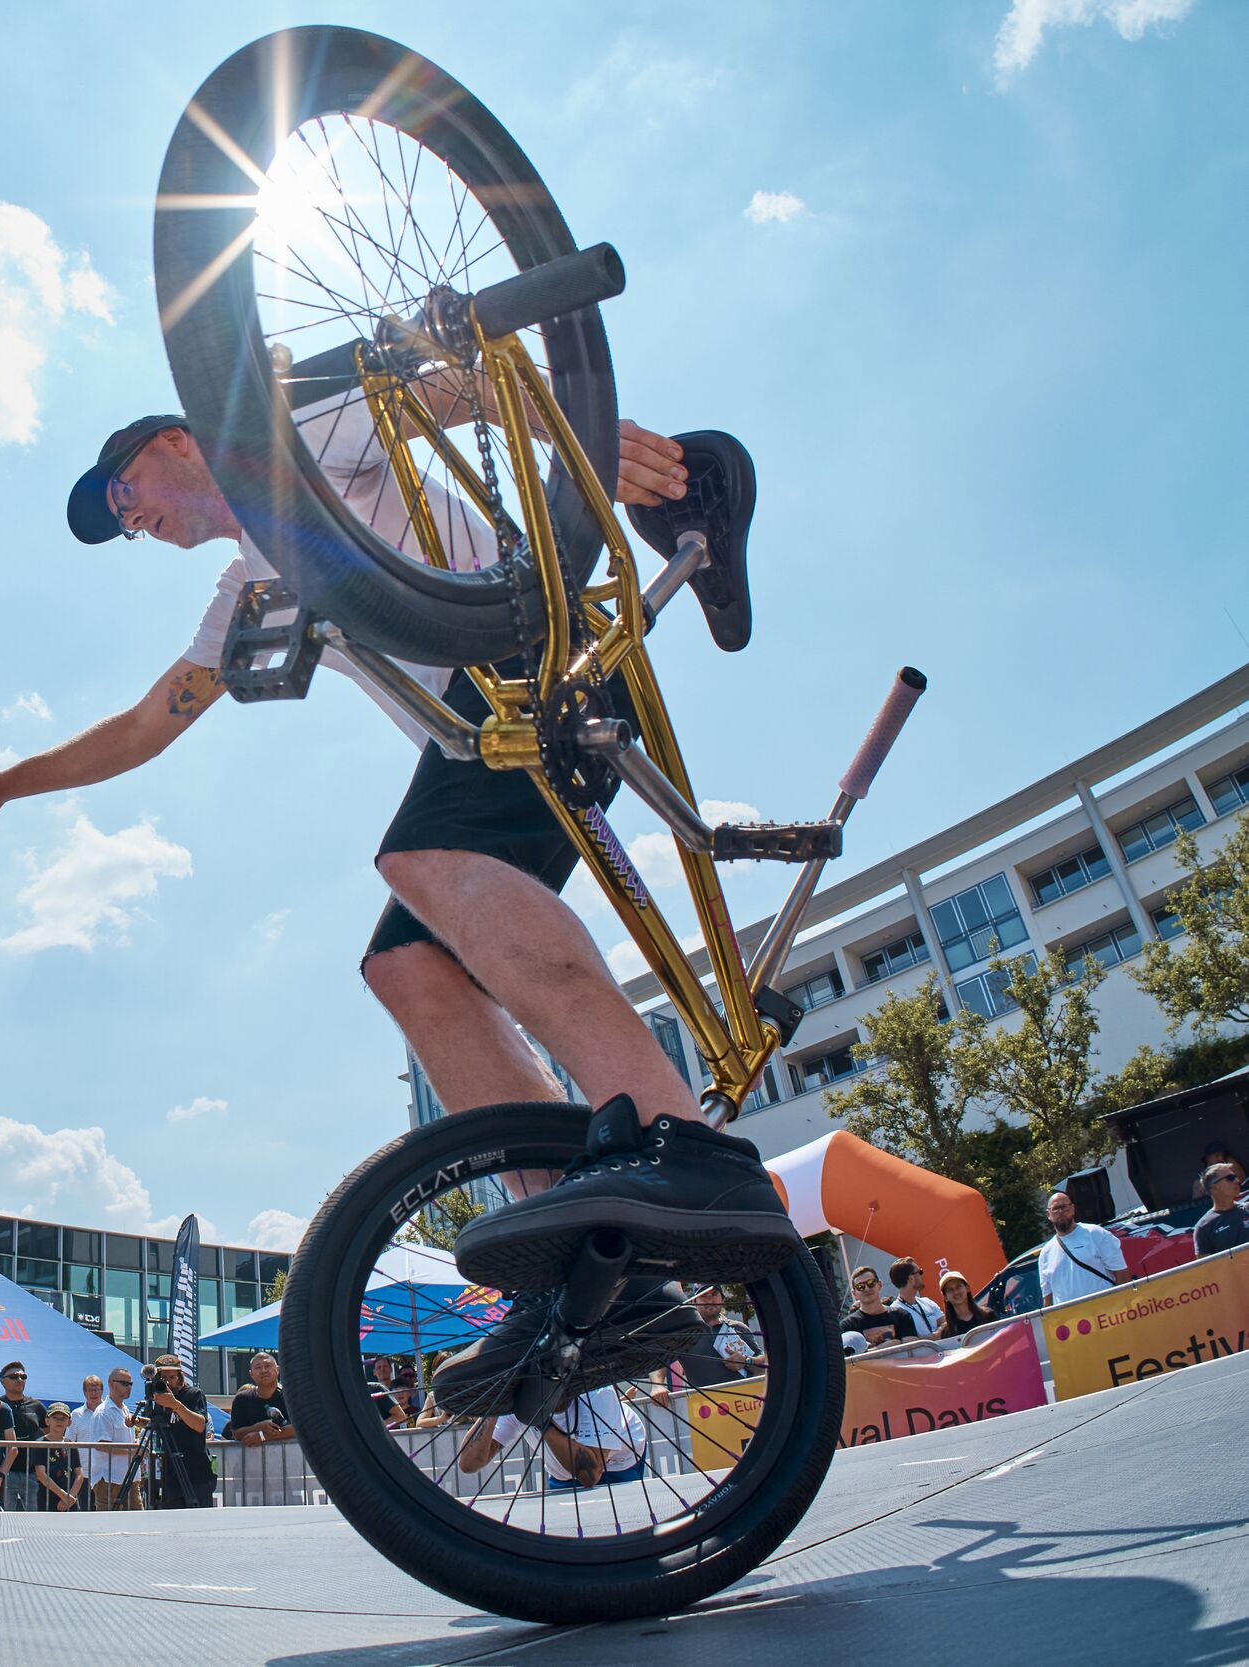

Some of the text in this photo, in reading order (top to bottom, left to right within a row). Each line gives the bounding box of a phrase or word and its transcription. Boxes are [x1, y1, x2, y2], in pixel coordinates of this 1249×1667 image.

[390, 1160, 465, 1224] ECLAT
[1097, 1282, 1220, 1330] Eurobike.com
[1107, 1328, 1249, 1387] Festiv
